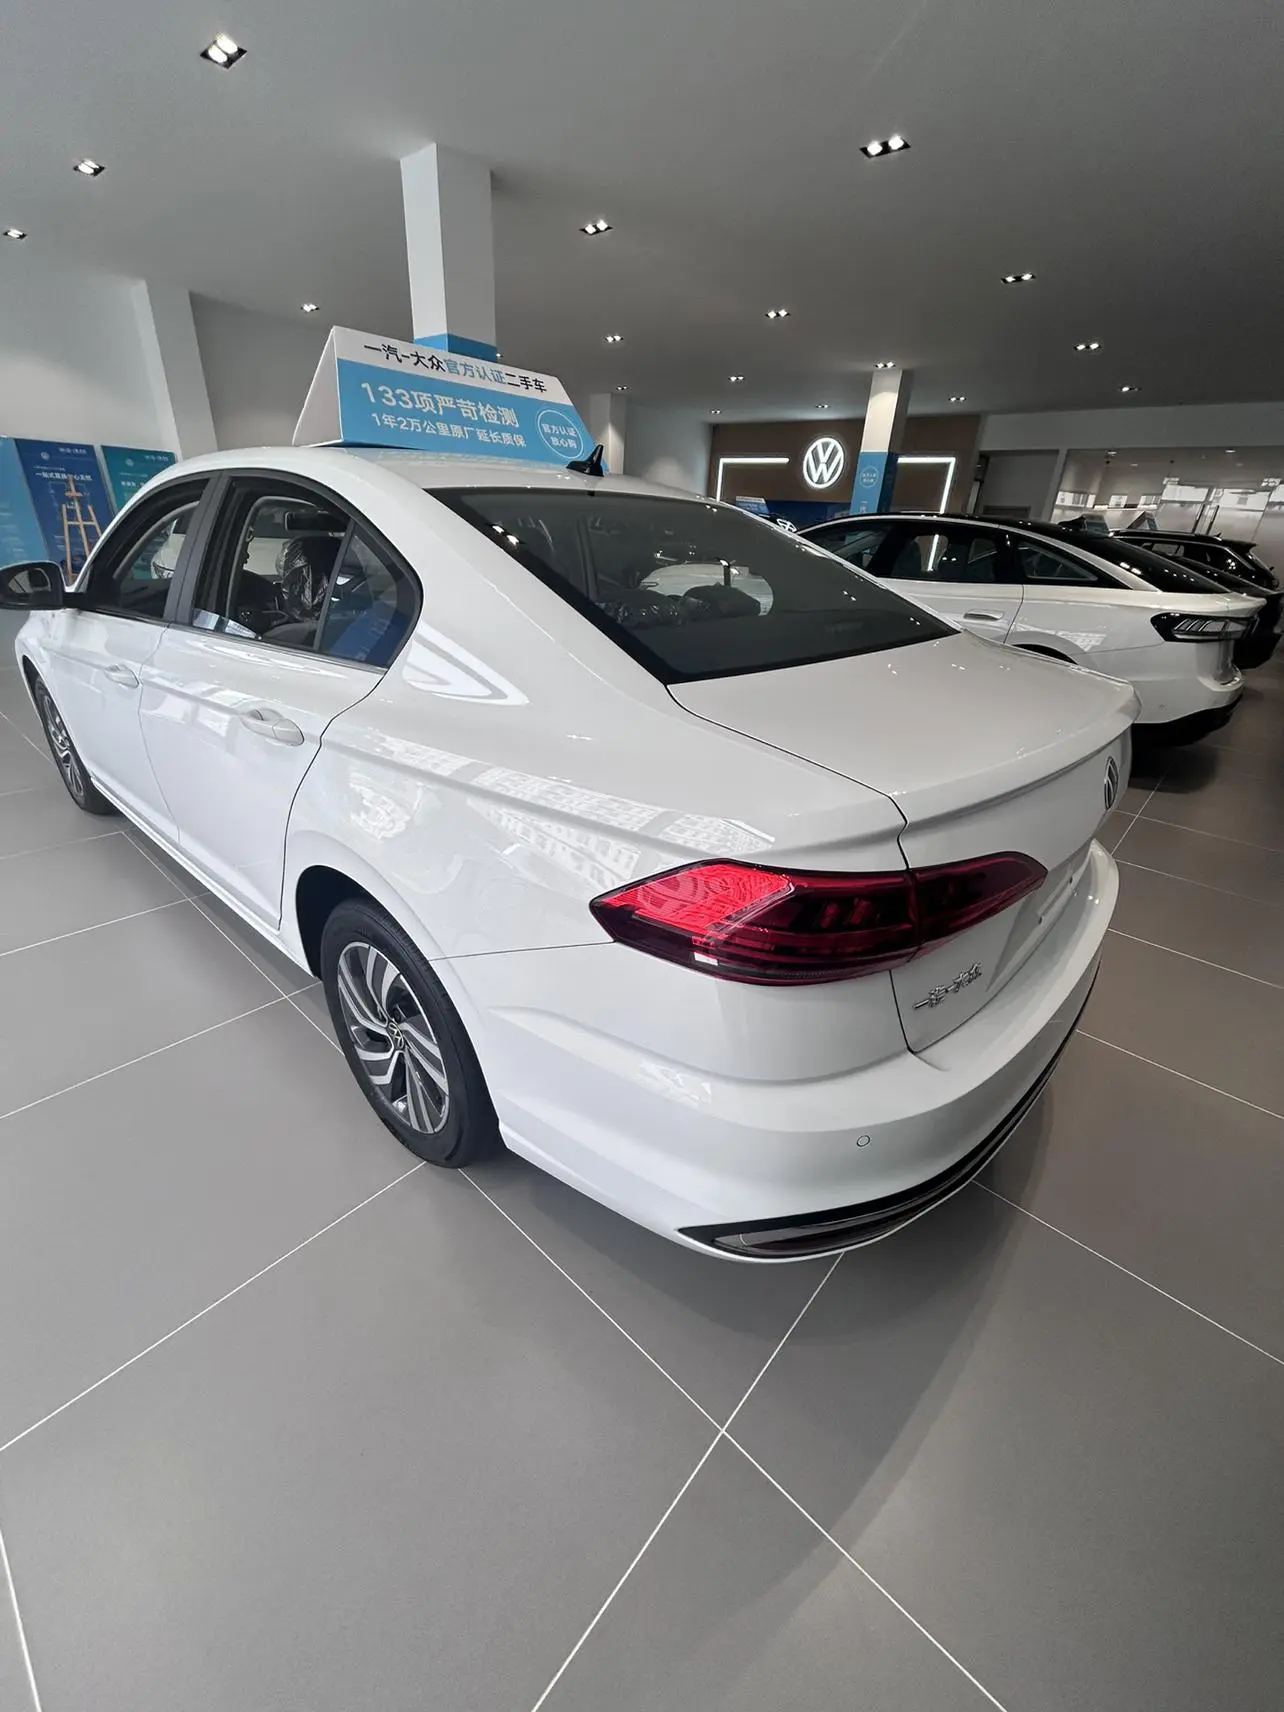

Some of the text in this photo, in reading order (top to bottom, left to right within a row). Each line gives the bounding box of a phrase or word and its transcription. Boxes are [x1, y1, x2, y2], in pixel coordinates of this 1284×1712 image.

[363, 343, 548, 393] 一汽-大众官方认证二手车
[361, 382, 520, 428] 133项严苛检测
[371, 412, 527, 447] 1年2万公里原厂延长质保
